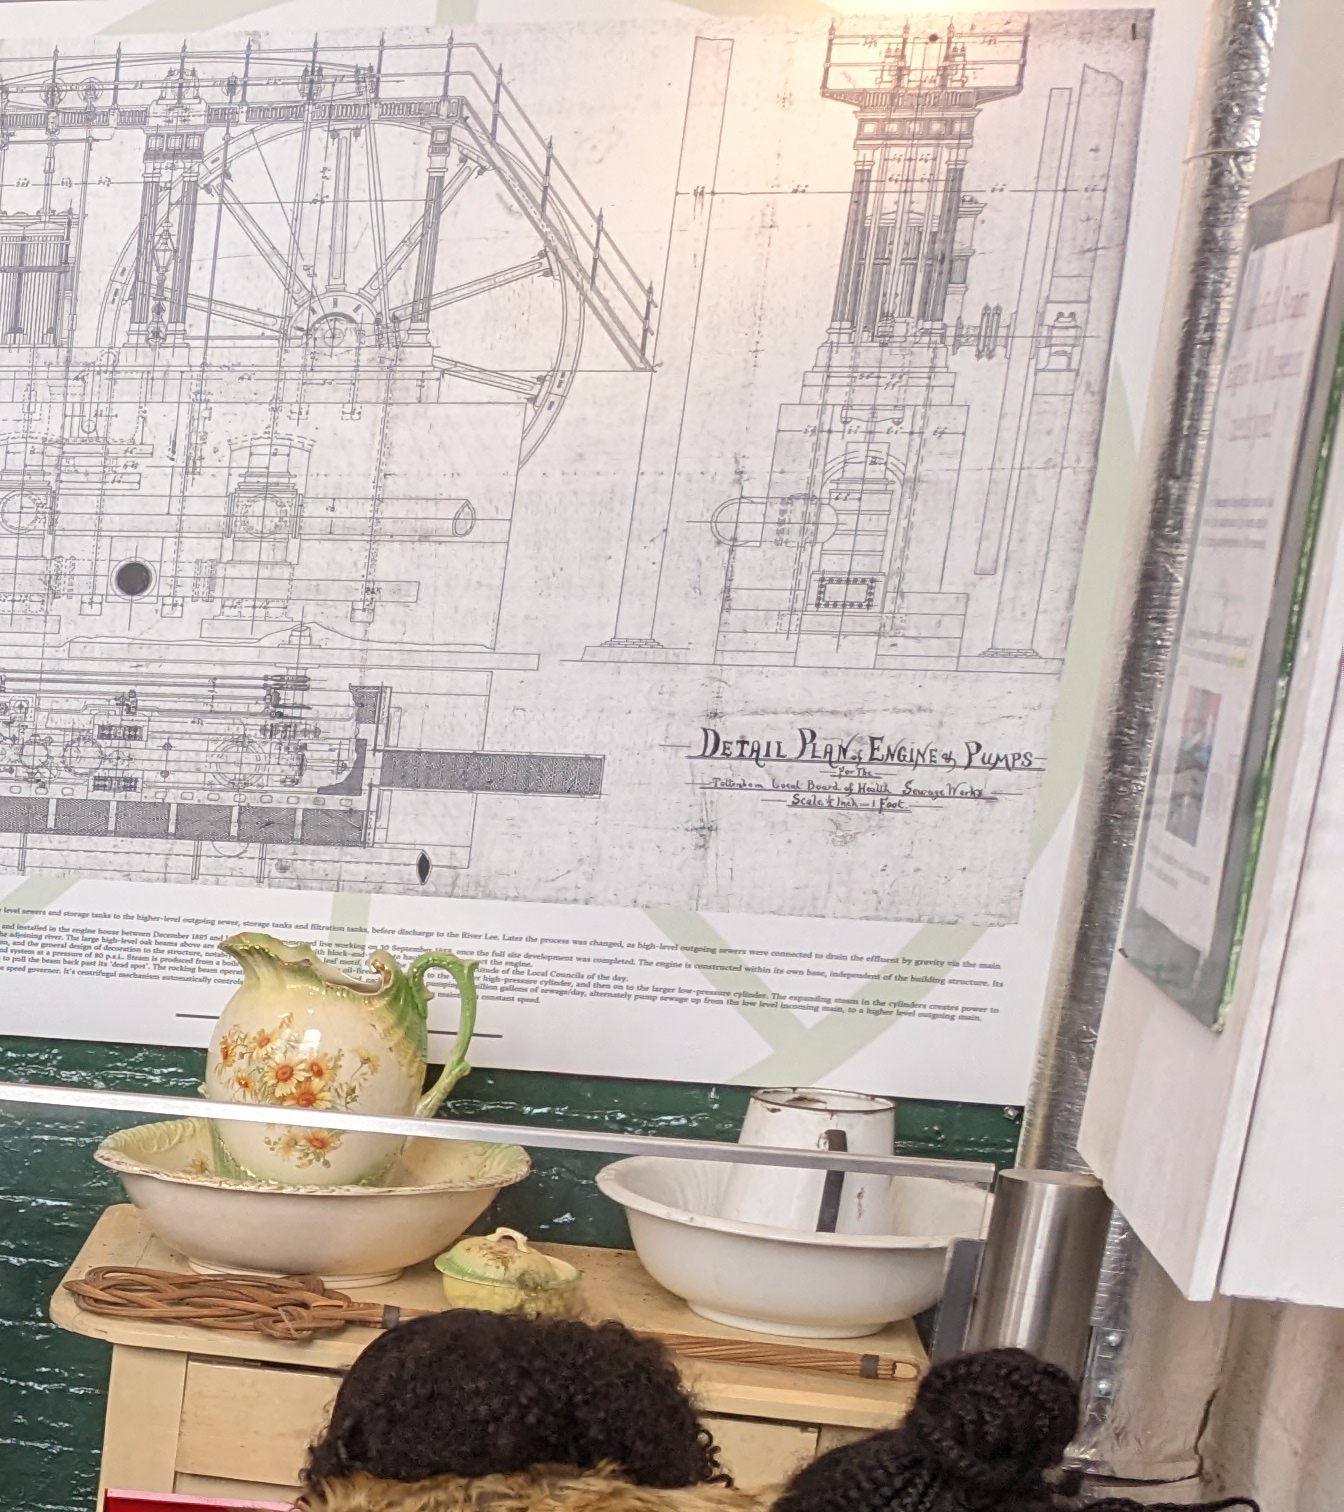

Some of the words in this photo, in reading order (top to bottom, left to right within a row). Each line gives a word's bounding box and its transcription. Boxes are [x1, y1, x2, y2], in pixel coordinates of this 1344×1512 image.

[772, 779, 801, 789] Local
[808, 780, 840, 790] Board
[844, 782, 853, 796] of
[858, 782, 891, 793] Health
[903, 779, 944, 800] Sewage
[947, 782, 983, 797] Works
[3, 906, 20, 914] level
[63, 911, 89, 919] storage
[136, 914, 181, 922] higher-level
[182, 917, 216, 926] outgoing
[217, 919, 240, 927] sewer,
[271, 921, 292, 929] tanks
[294, 922, 309, 930] and
[310, 923, 344, 931] filtration
[371, 926, 396, 934] before
[484, 932, 499, 940] Lee.
[502, 933, 523, 941] Later
[588, 939, 624, 948] changed,
[637, 941, 678, 950] high-level
[679, 945, 717, 954] outgoing
[825, 952, 847, 960] drain
[850, 953, 864, 961] the
[865, 955, 899, 963] effluent
[914, 959, 945, 967] gravity
[962, 960, 976, 968] the
